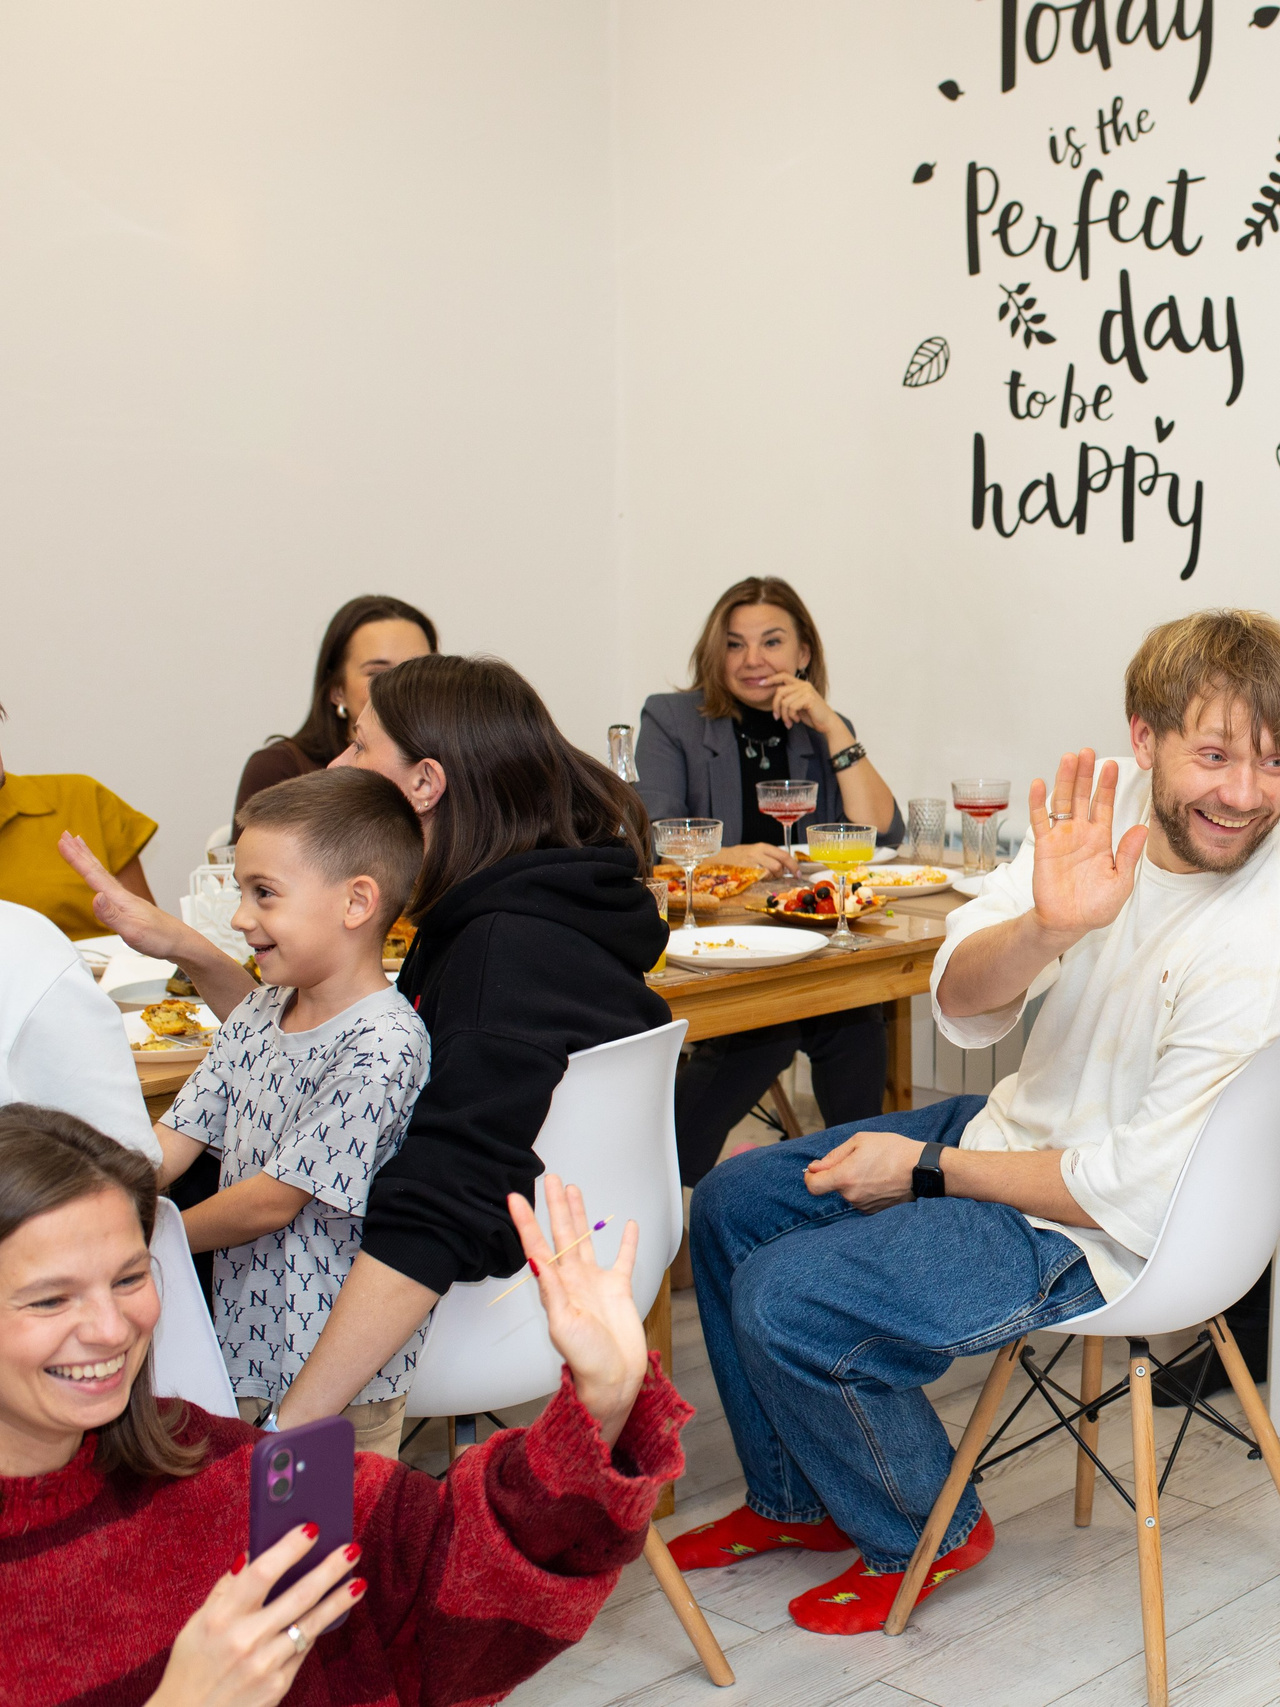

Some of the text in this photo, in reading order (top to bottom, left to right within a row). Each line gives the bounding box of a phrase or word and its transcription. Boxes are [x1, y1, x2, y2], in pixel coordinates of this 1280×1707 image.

[1049, 96, 1155, 168] is the
[966, 161, 1206, 281] Perfect
[1099, 268, 1244, 407] day
[1004, 363, 1114, 428] to be
[971, 432, 1204, 581] happy
[239, 1050, 258, 1071] N
[267, 1073, 284, 1093] N
[330, 1089, 352, 1108] N
[195, 1109, 215, 1129] N
[257, 1110, 272, 1131] N
[361, 1101, 382, 1124] N
[310, 1122, 330, 1143] N
[251, 1147, 266, 1167] N
[347, 1137, 368, 1159] N
[296, 1155, 316, 1176] N
[331, 1172, 352, 1194] N
[313, 1218, 329, 1236] N
[251, 1253, 268, 1271] N
[315, 1256, 330, 1275] N
[250, 1289, 268, 1307] N
[250, 1324, 266, 1341] N
[249, 1359, 264, 1378] N
